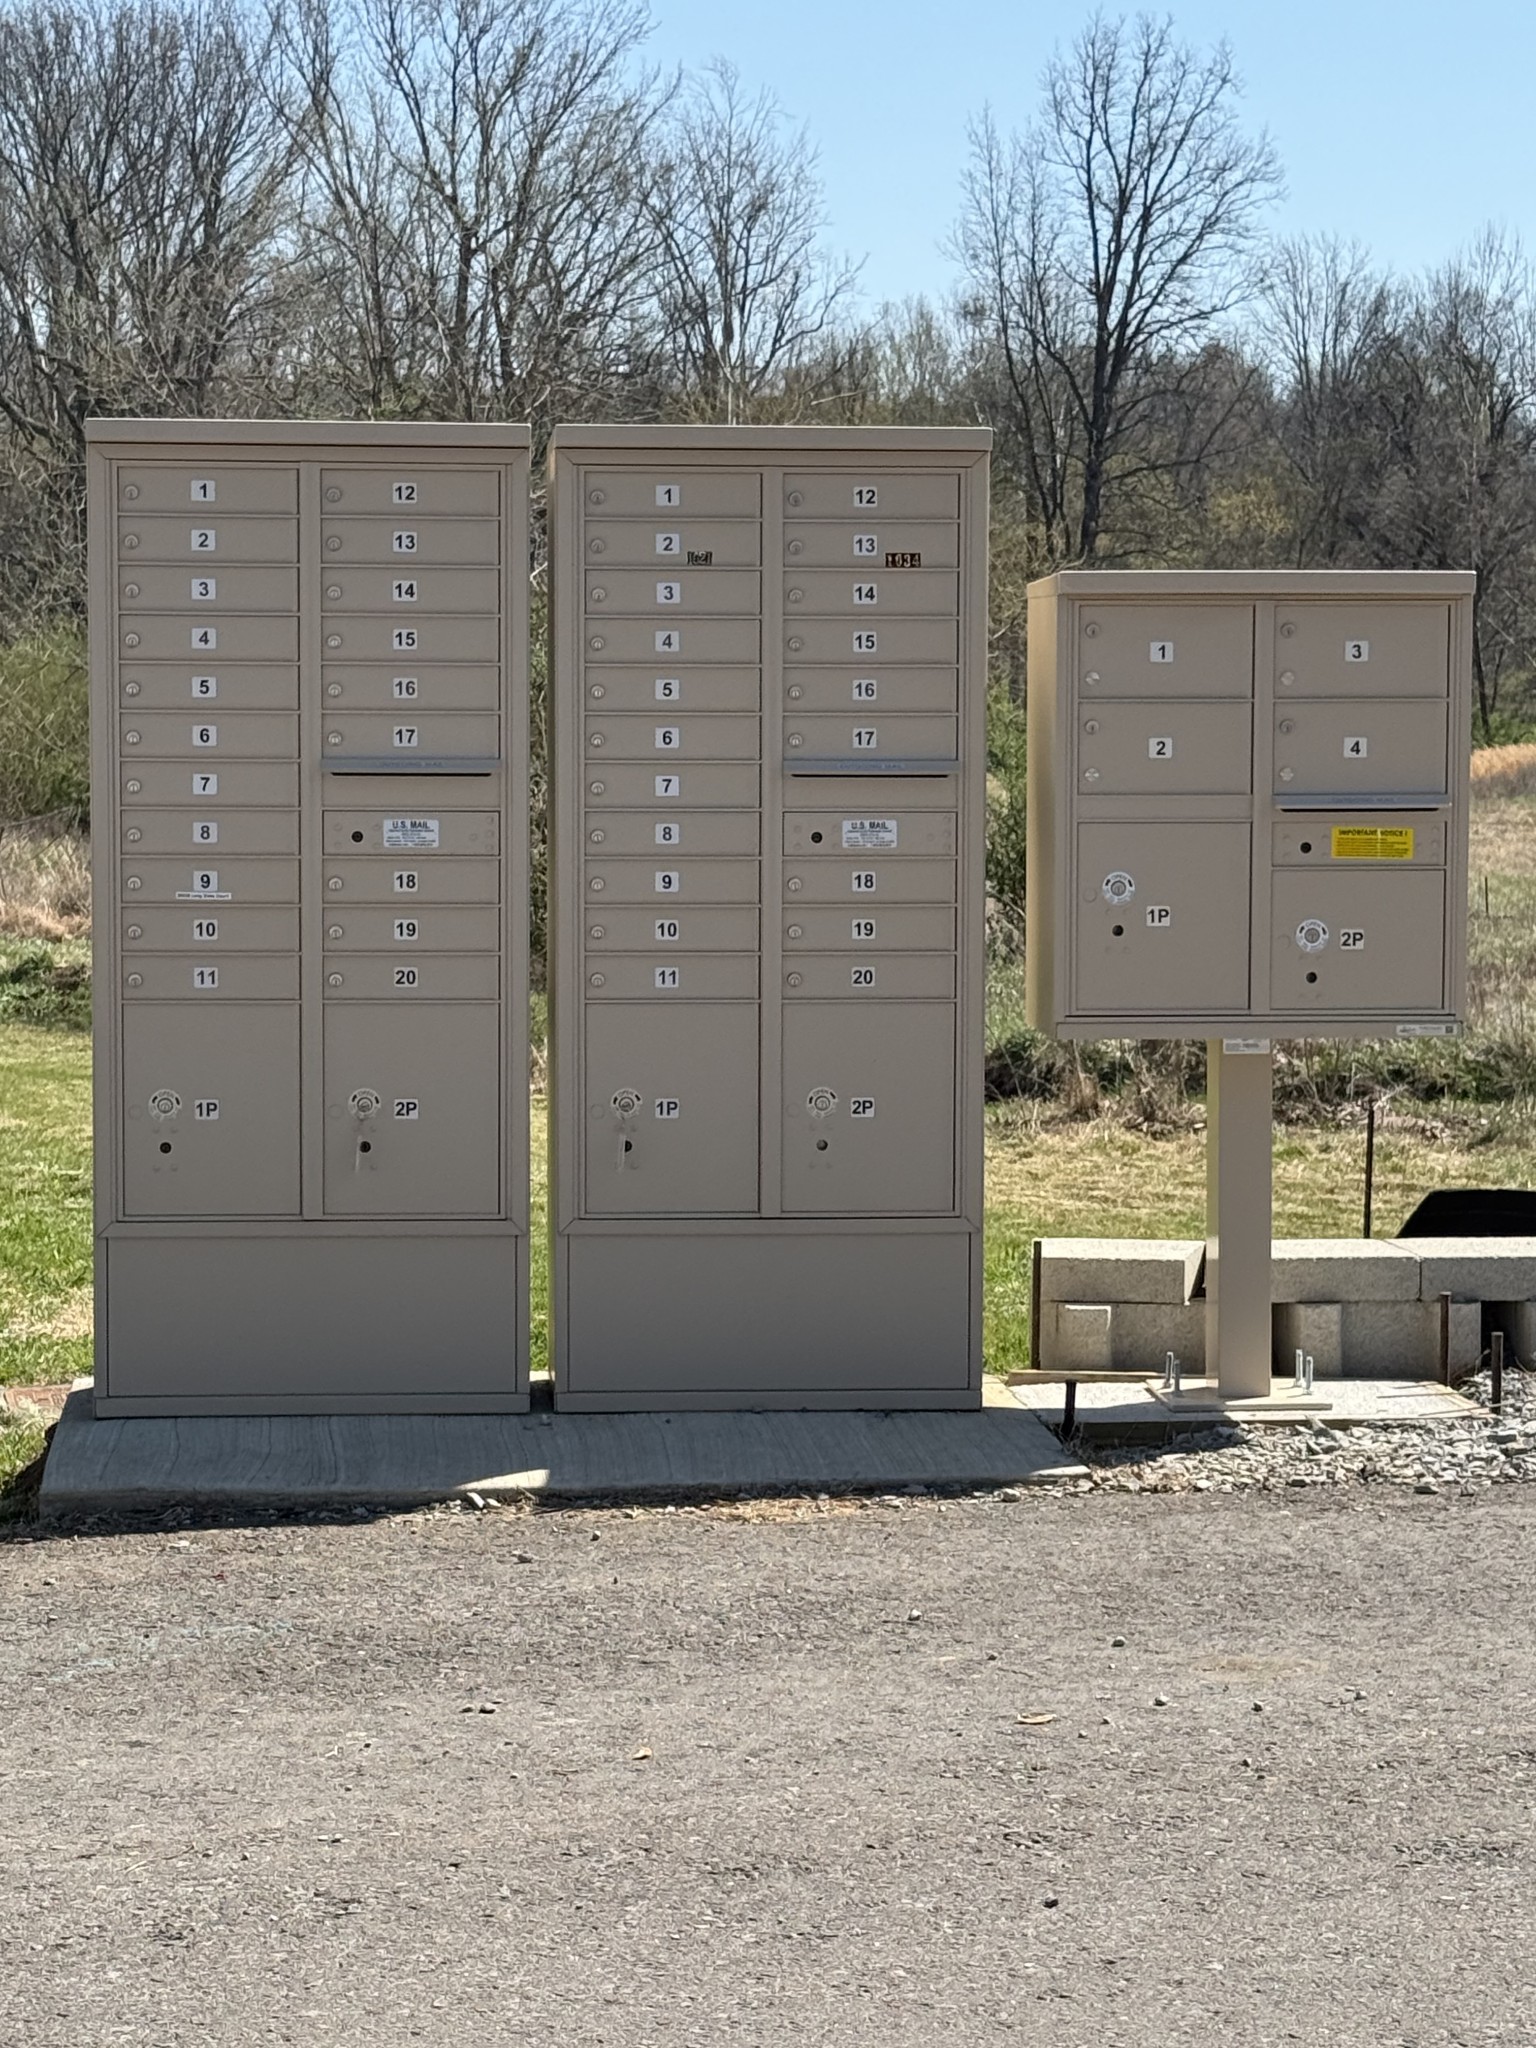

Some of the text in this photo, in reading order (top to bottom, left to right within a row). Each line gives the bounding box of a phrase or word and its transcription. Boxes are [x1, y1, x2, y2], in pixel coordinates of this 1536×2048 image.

[198, 483, 208, 498] 1
[395, 486, 415, 500] 12
[664, 488, 672, 503] 1
[856, 489, 875, 504] 12
[199, 533, 208, 547] 2
[395, 535, 415, 549] 13
[663, 537, 673, 551] 2
[856, 538, 875, 553] 13
[199, 582, 209, 596] 3
[395, 583, 415, 598] 14
[664, 586, 673, 600] 3
[855, 586, 875, 601] 14
[199, 631, 209, 645] 4
[395, 632, 415, 646] 15
[662, 634, 672, 648] 4
[855, 634, 875, 649] 15
[1157, 645, 1166, 659] 1
[1352, 644, 1362, 659] 3
[200, 680, 209, 694] 5
[395, 681, 415, 696] 16
[663, 682, 672, 697] 5
[855, 682, 874, 697] 16
[200, 728, 210, 743] 6
[396, 729, 415, 743] 17
[663, 731, 672, 745] 6
[855, 731, 874, 745] 17
[1156, 741, 1166, 755] 2
[1350, 741, 1360, 755] 4
[200, 777, 210, 791] 7
[662, 779, 672, 793] 7
[392, 821, 430, 829] U.S. MAIL
[851, 821, 888, 830] U.S. MAIL
[200, 825, 210, 840] 8
[663, 826, 672, 841] 8
[201, 874, 210, 889] 9
[396, 874, 416, 889] 18
[662, 875, 672, 889] 9
[855, 874, 873, 888] 18
[1147, 909, 1169, 923] 1P
[196, 922, 215, 937] 10
[397, 922, 416, 937] 19
[658, 923, 677, 937] 10
[855, 922, 873, 936] 19
[1342, 932, 1363, 946] 2P
[197, 970, 215, 985] 11
[395, 970, 416, 984] 20
[659, 970, 676, 985] 11
[853, 970, 873, 984] 20
[196, 1102, 217, 1117] 1P
[396, 1102, 417, 1116] 2P
[656, 1101, 678, 1116] 1P
[852, 1100, 873, 1114] 2P
